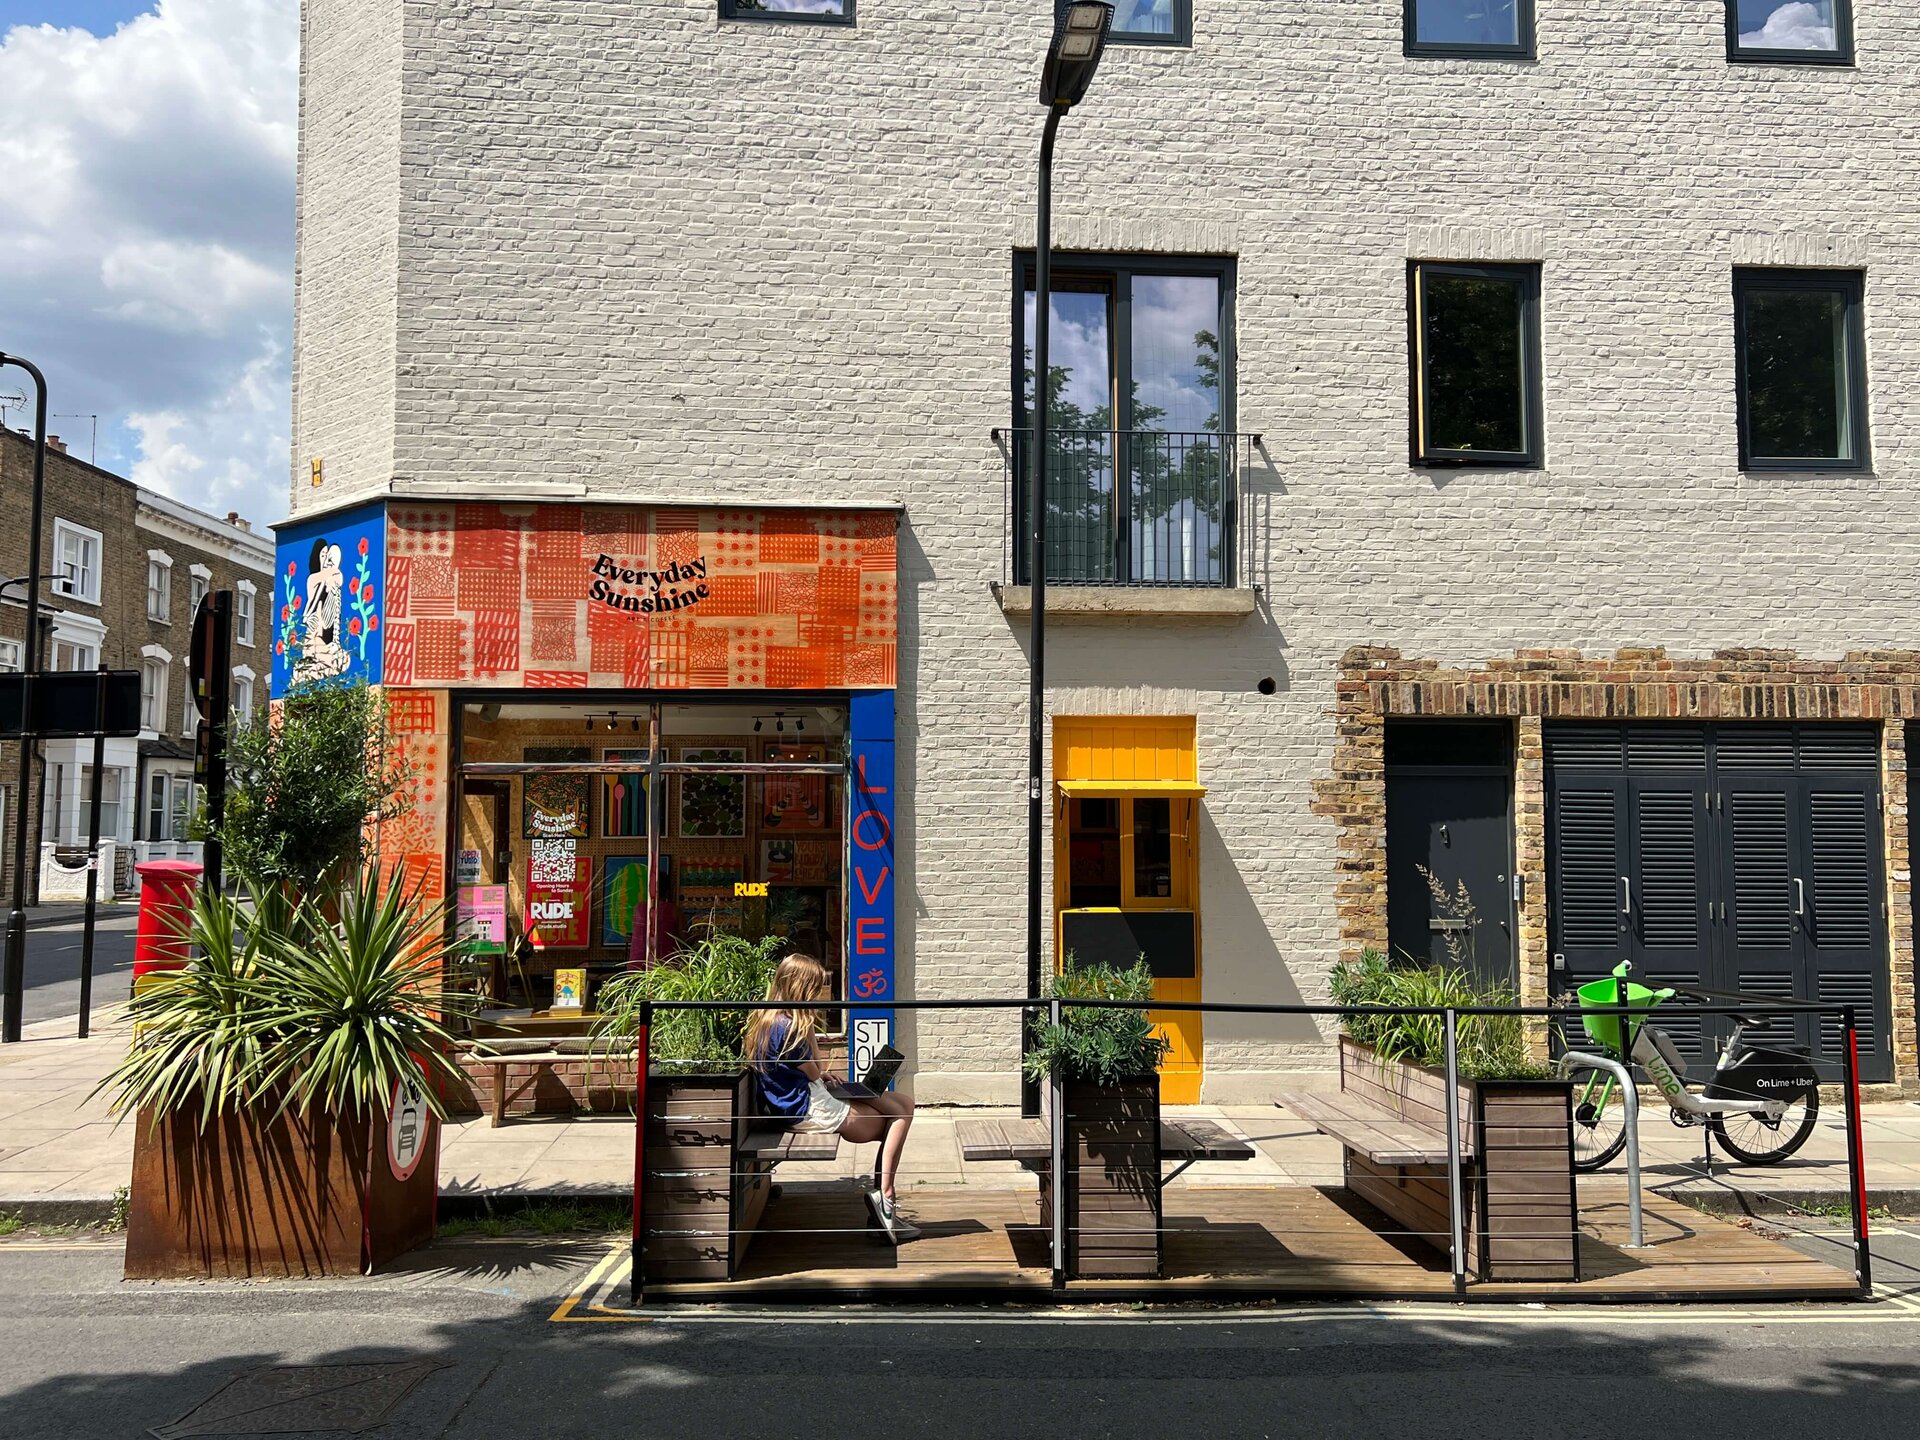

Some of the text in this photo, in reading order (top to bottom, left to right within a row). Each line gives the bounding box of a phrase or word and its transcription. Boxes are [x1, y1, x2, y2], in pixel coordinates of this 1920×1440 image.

[591, 553, 707, 592] Everyday
[589, 579, 710, 613] Sunshine
[534, 810, 576, 823] Everyday
[532, 820, 577, 833] Sunshine
[853, 755, 890, 955] LOVE
[734, 883, 768, 896] RUDE
[530, 902, 574, 919] RUDE
[1756, 1079, 1770, 1088] On
[1771, 1079, 1789, 1087] Lime
[1796, 1078, 1813, 1087] Uber
